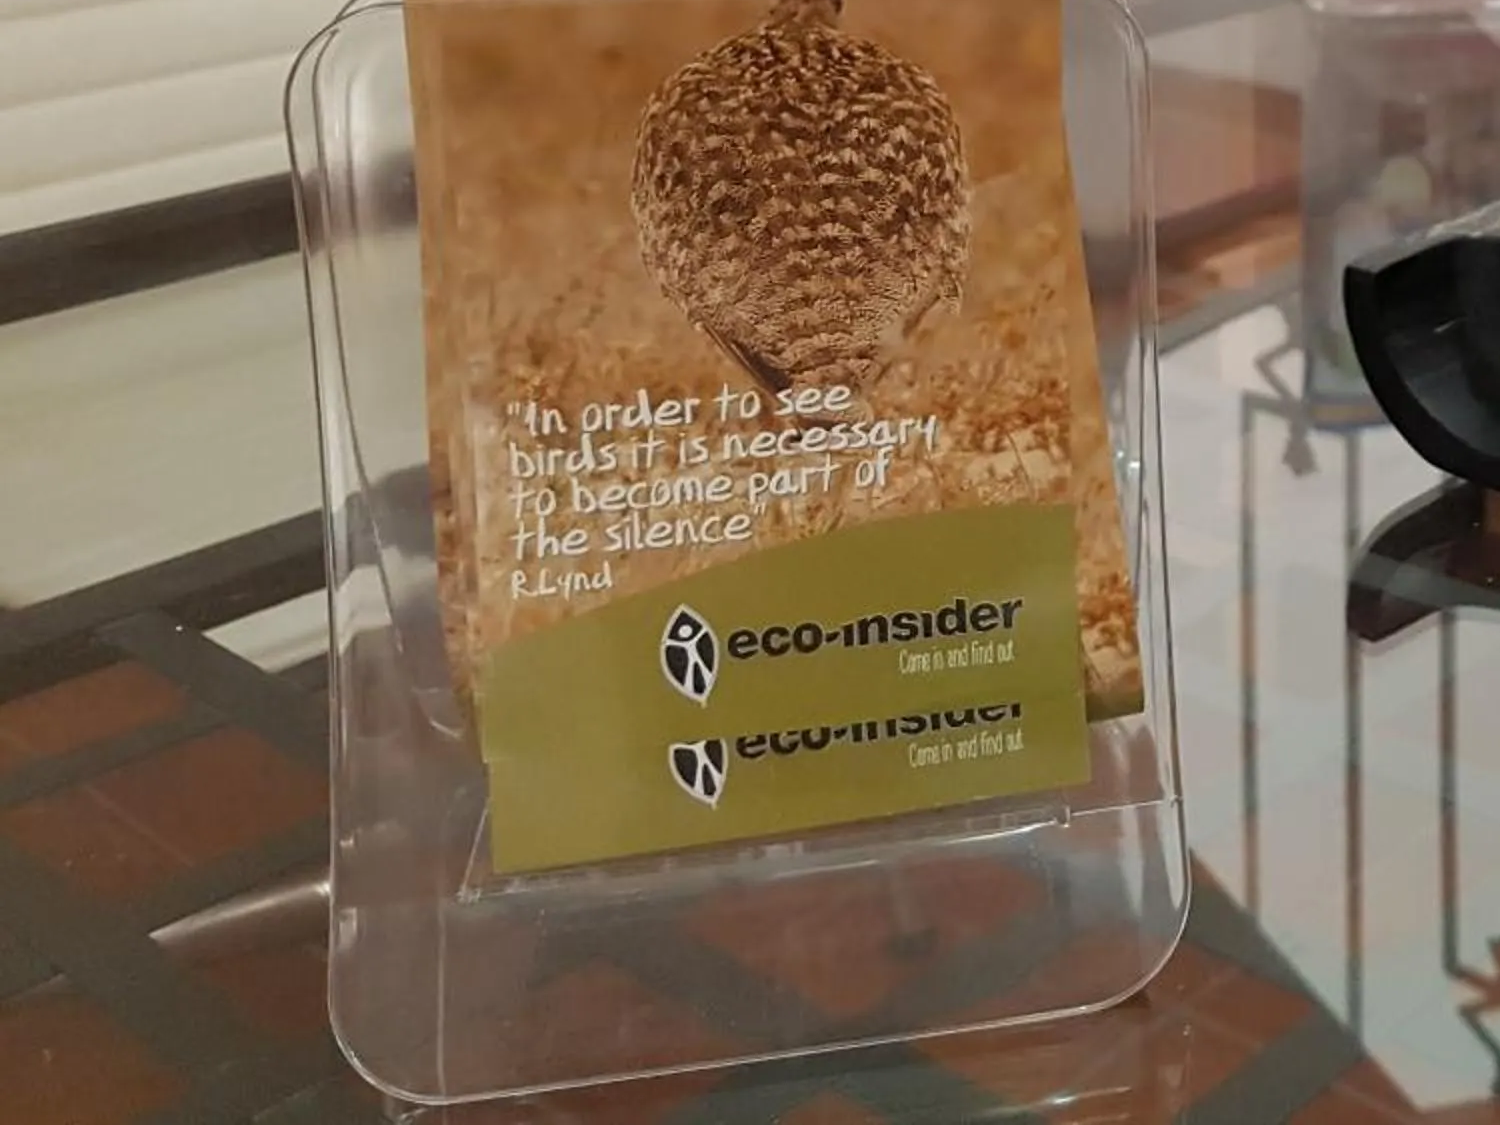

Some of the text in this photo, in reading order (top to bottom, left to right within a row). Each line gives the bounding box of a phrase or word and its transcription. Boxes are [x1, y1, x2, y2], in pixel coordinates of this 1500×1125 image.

[582, 388, 701, 433] order
[713, 383, 761, 422] to
[773, 385, 852, 416] see
[509, 415, 938, 478] birds it is necessary
[509, 445, 896, 520] to become part of
[509, 518, 589, 561] the
[727, 597, 1025, 661] eco-insider
[898, 638, 1015, 675] Come in and find out
[908, 727, 1025, 769] Come in and find out
